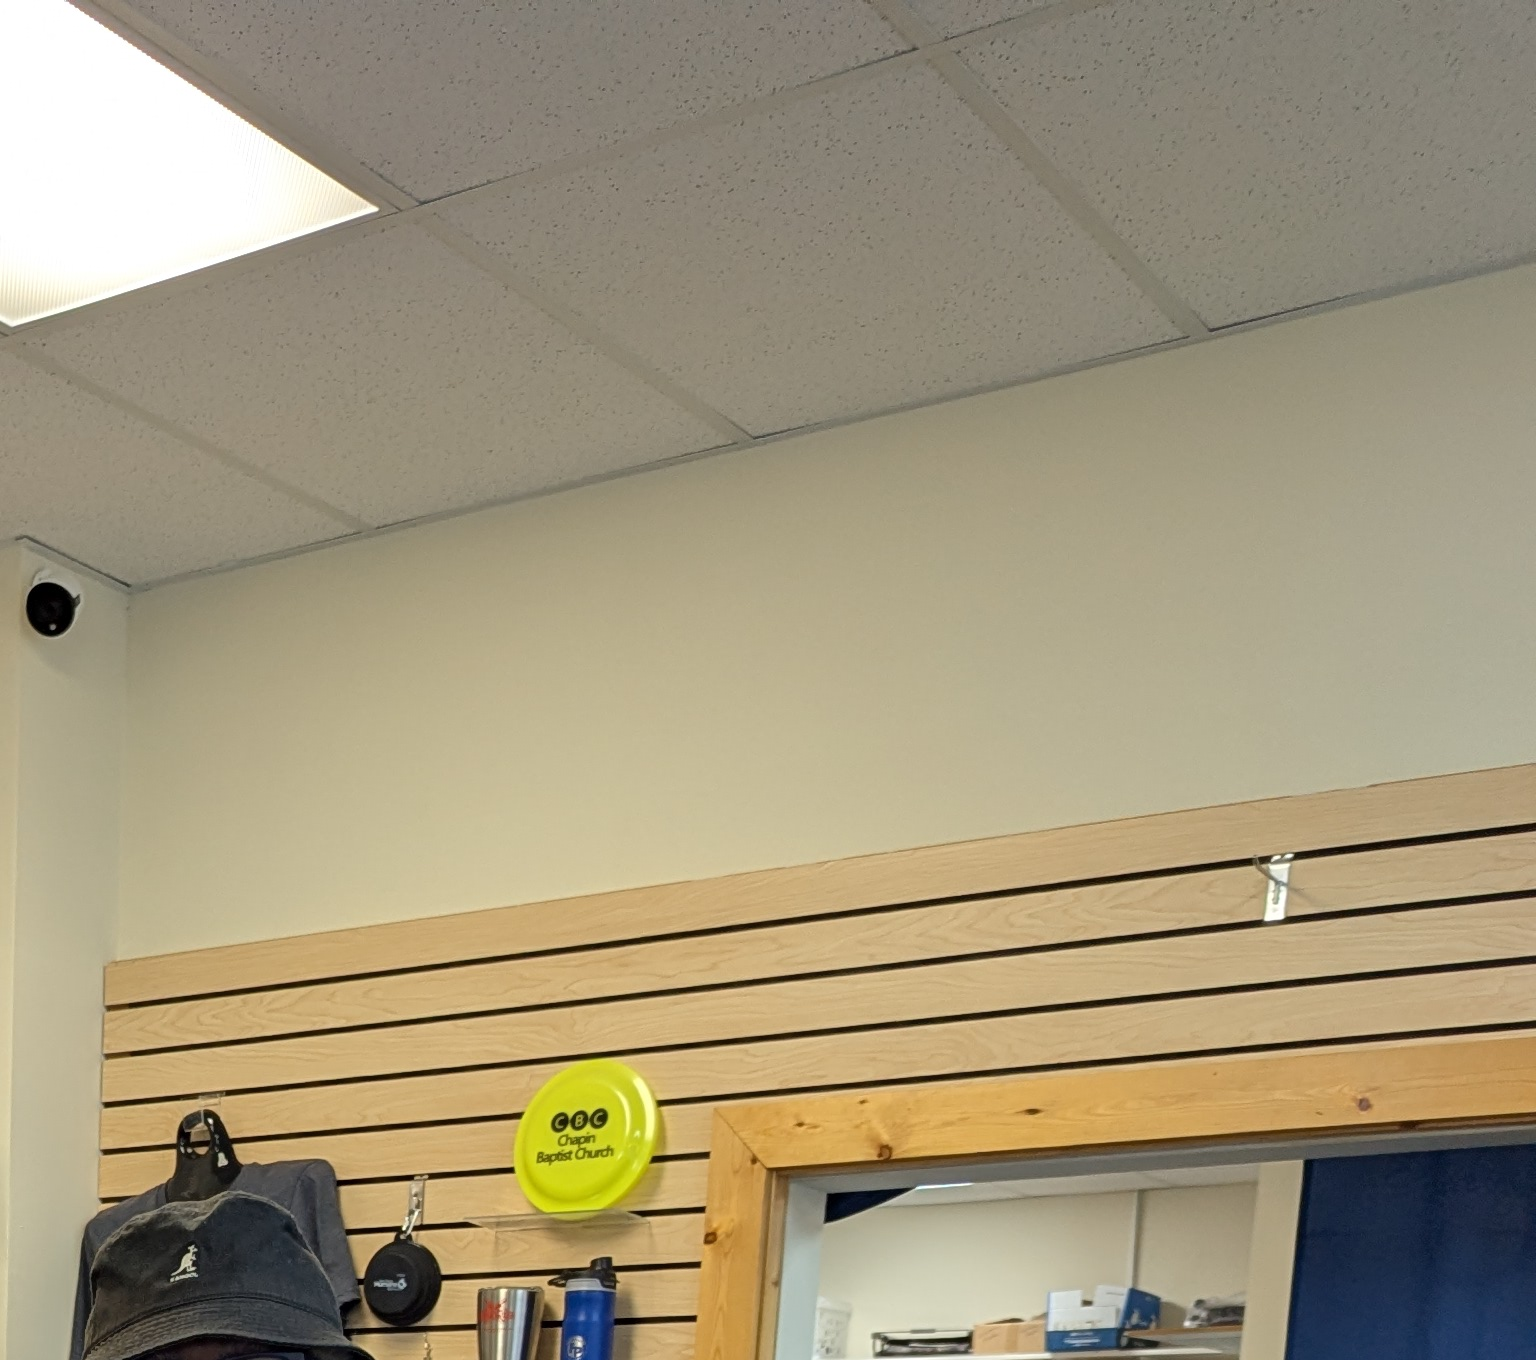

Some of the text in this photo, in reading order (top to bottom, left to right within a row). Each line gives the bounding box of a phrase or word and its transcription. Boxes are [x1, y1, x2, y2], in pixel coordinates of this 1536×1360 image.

[553, 1110, 606, 1131] CBC
[557, 1132, 596, 1148] Chapin
[536, 1145, 614, 1166] Baptist Church
